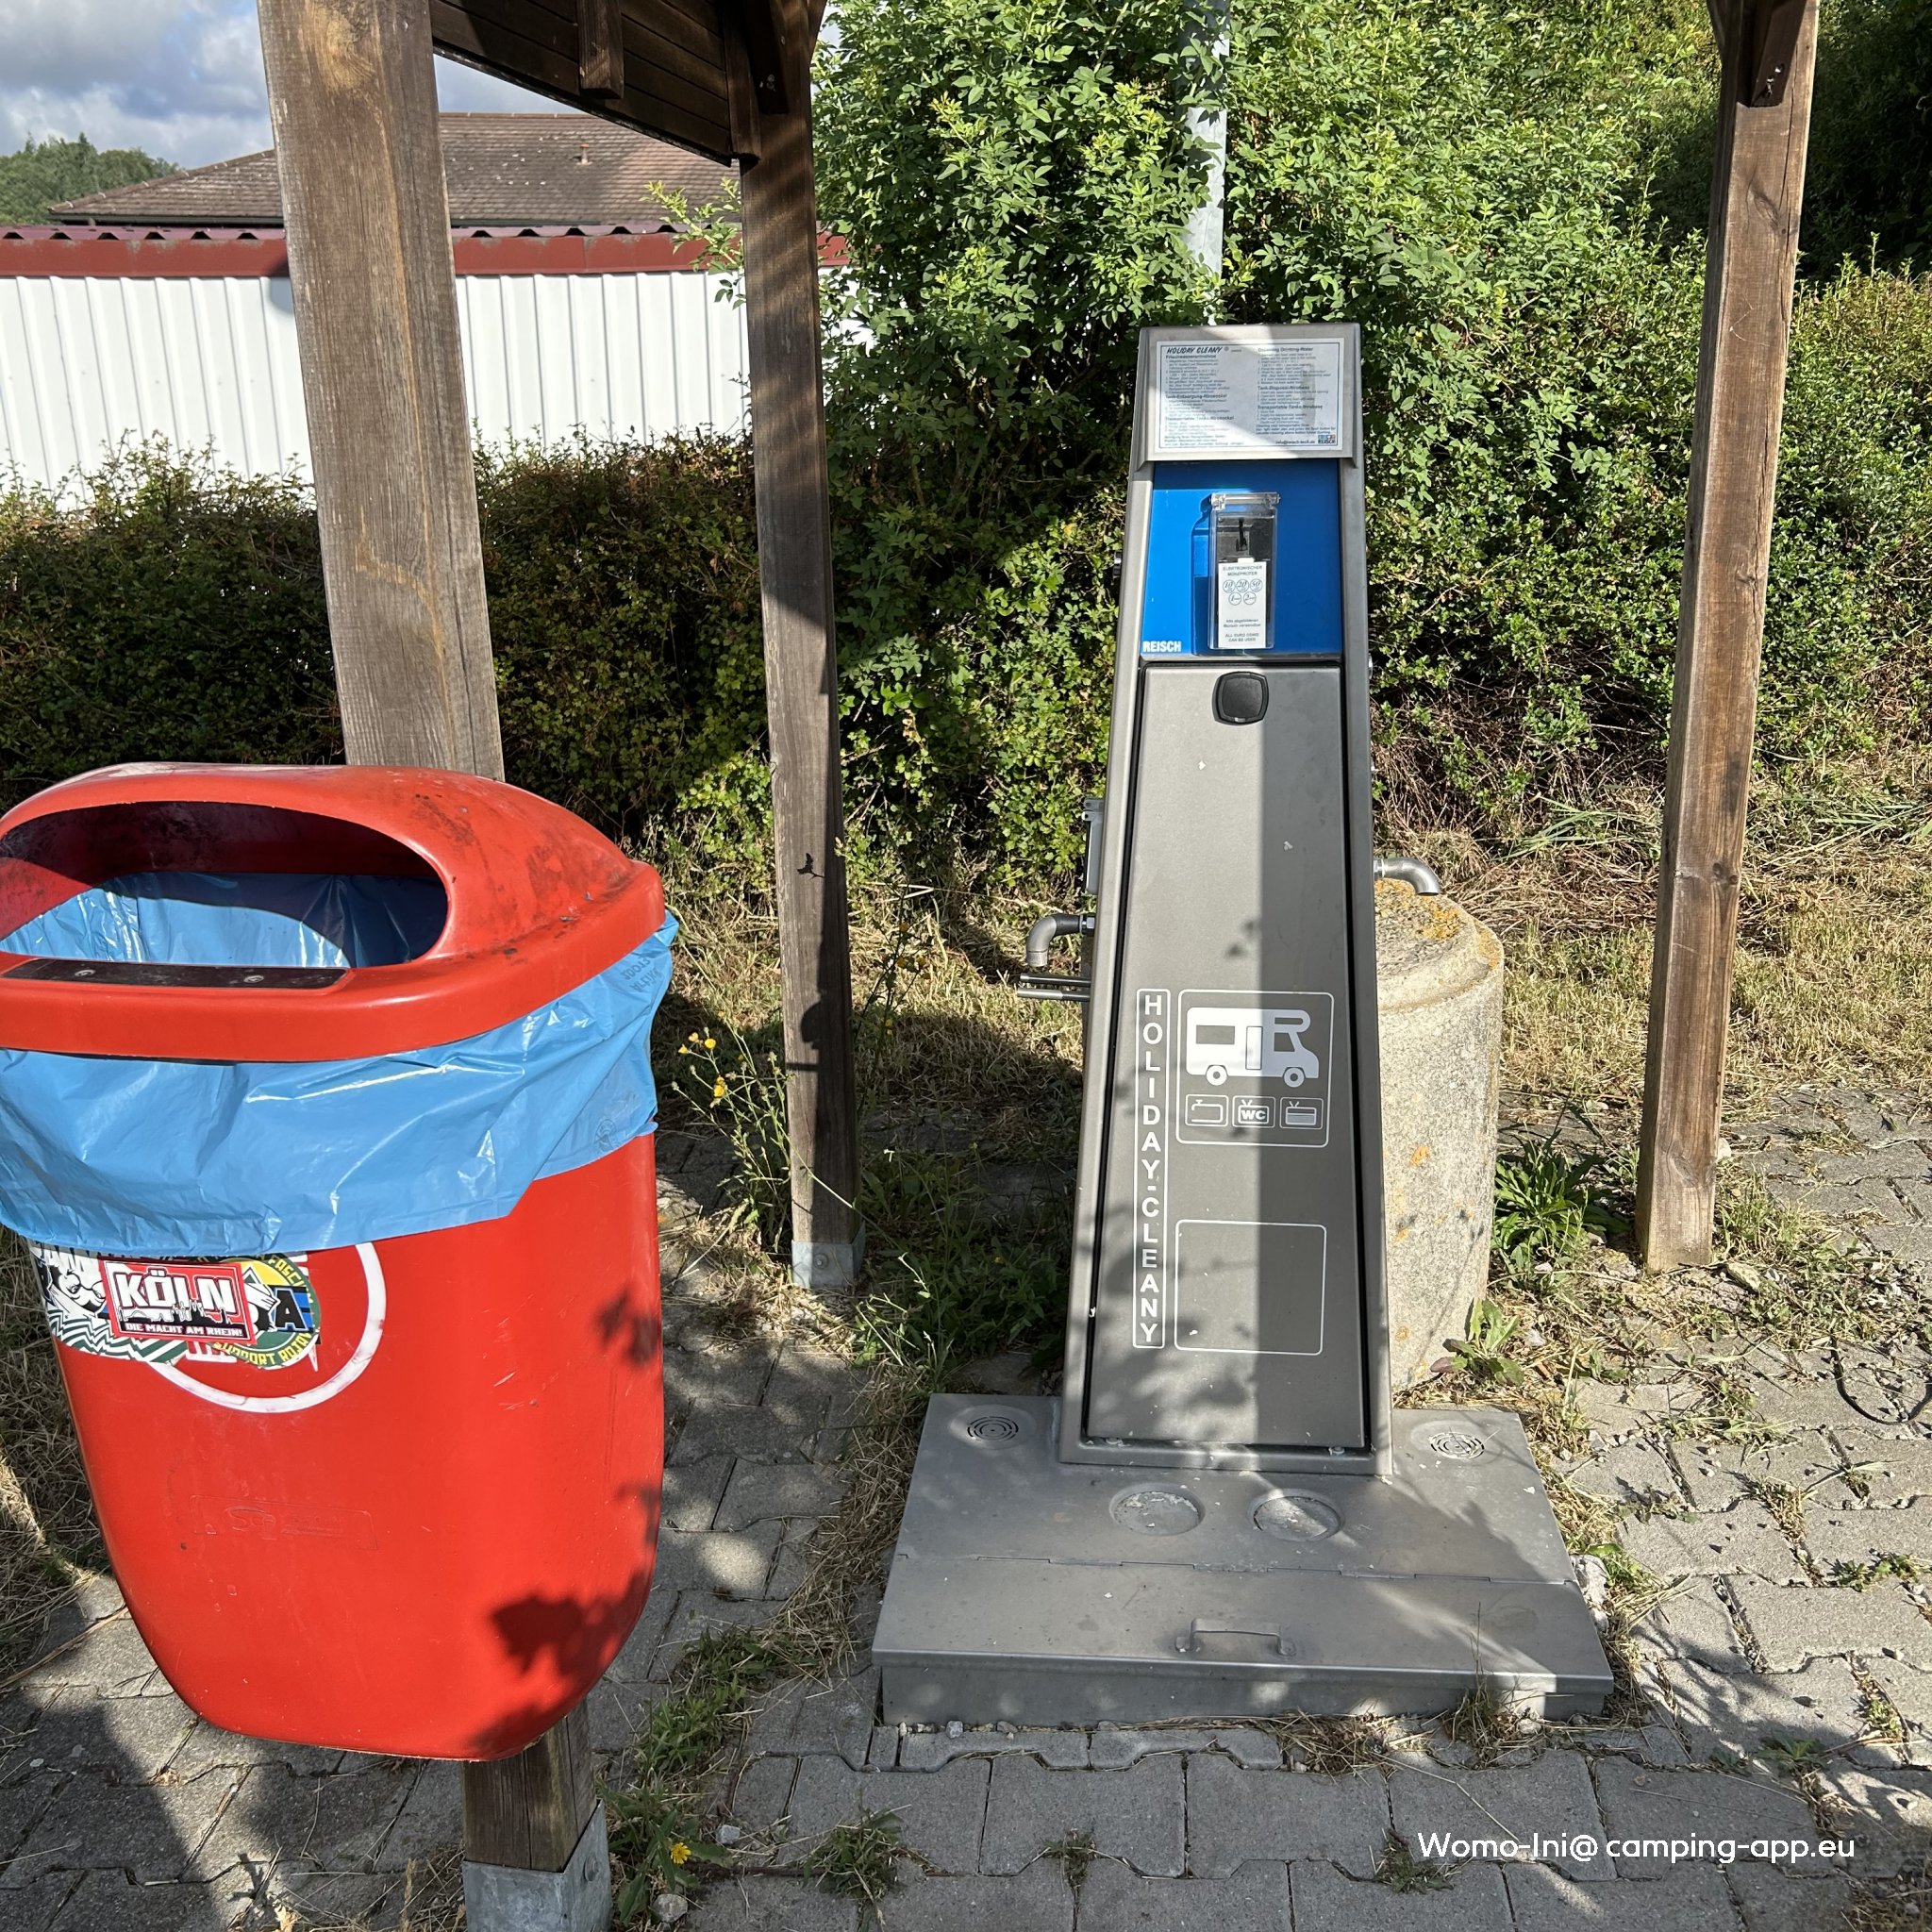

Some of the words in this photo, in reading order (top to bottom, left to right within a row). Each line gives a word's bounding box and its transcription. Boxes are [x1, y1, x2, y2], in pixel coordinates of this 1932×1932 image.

[1142, 641, 1182, 653] REISCH
[1241, 1108, 1267, 1122] WC
[113, 1267, 239, 1315] KÖLN
[125, 1322, 145, 1332] DIE
[145, 1323, 184, 1335] MACHT
[185, 1324, 205, 1336] AM
[205, 1326, 243, 1338] RHEIN!
